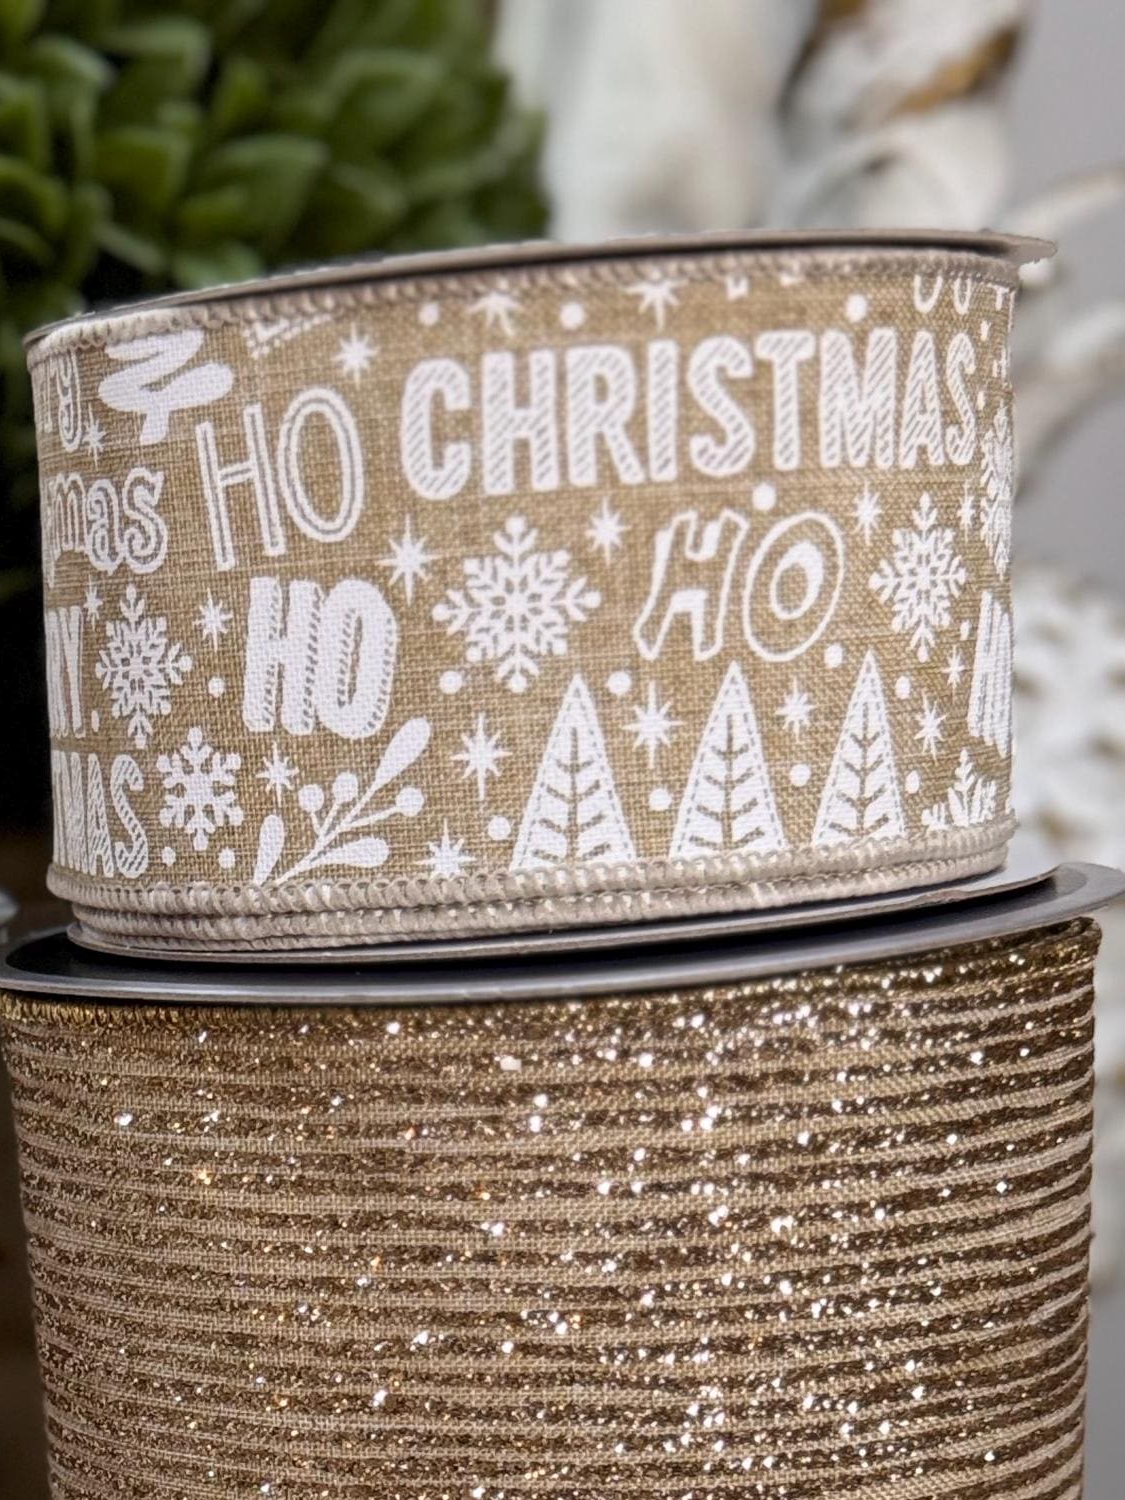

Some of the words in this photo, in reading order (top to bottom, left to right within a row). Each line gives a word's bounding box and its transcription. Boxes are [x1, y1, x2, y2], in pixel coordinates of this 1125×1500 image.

[195, 387, 365, 572] HO
[400, 327, 976, 500] CHRISTMAS
[242, 576, 398, 740] HO
[632, 508, 846, 663] HO
